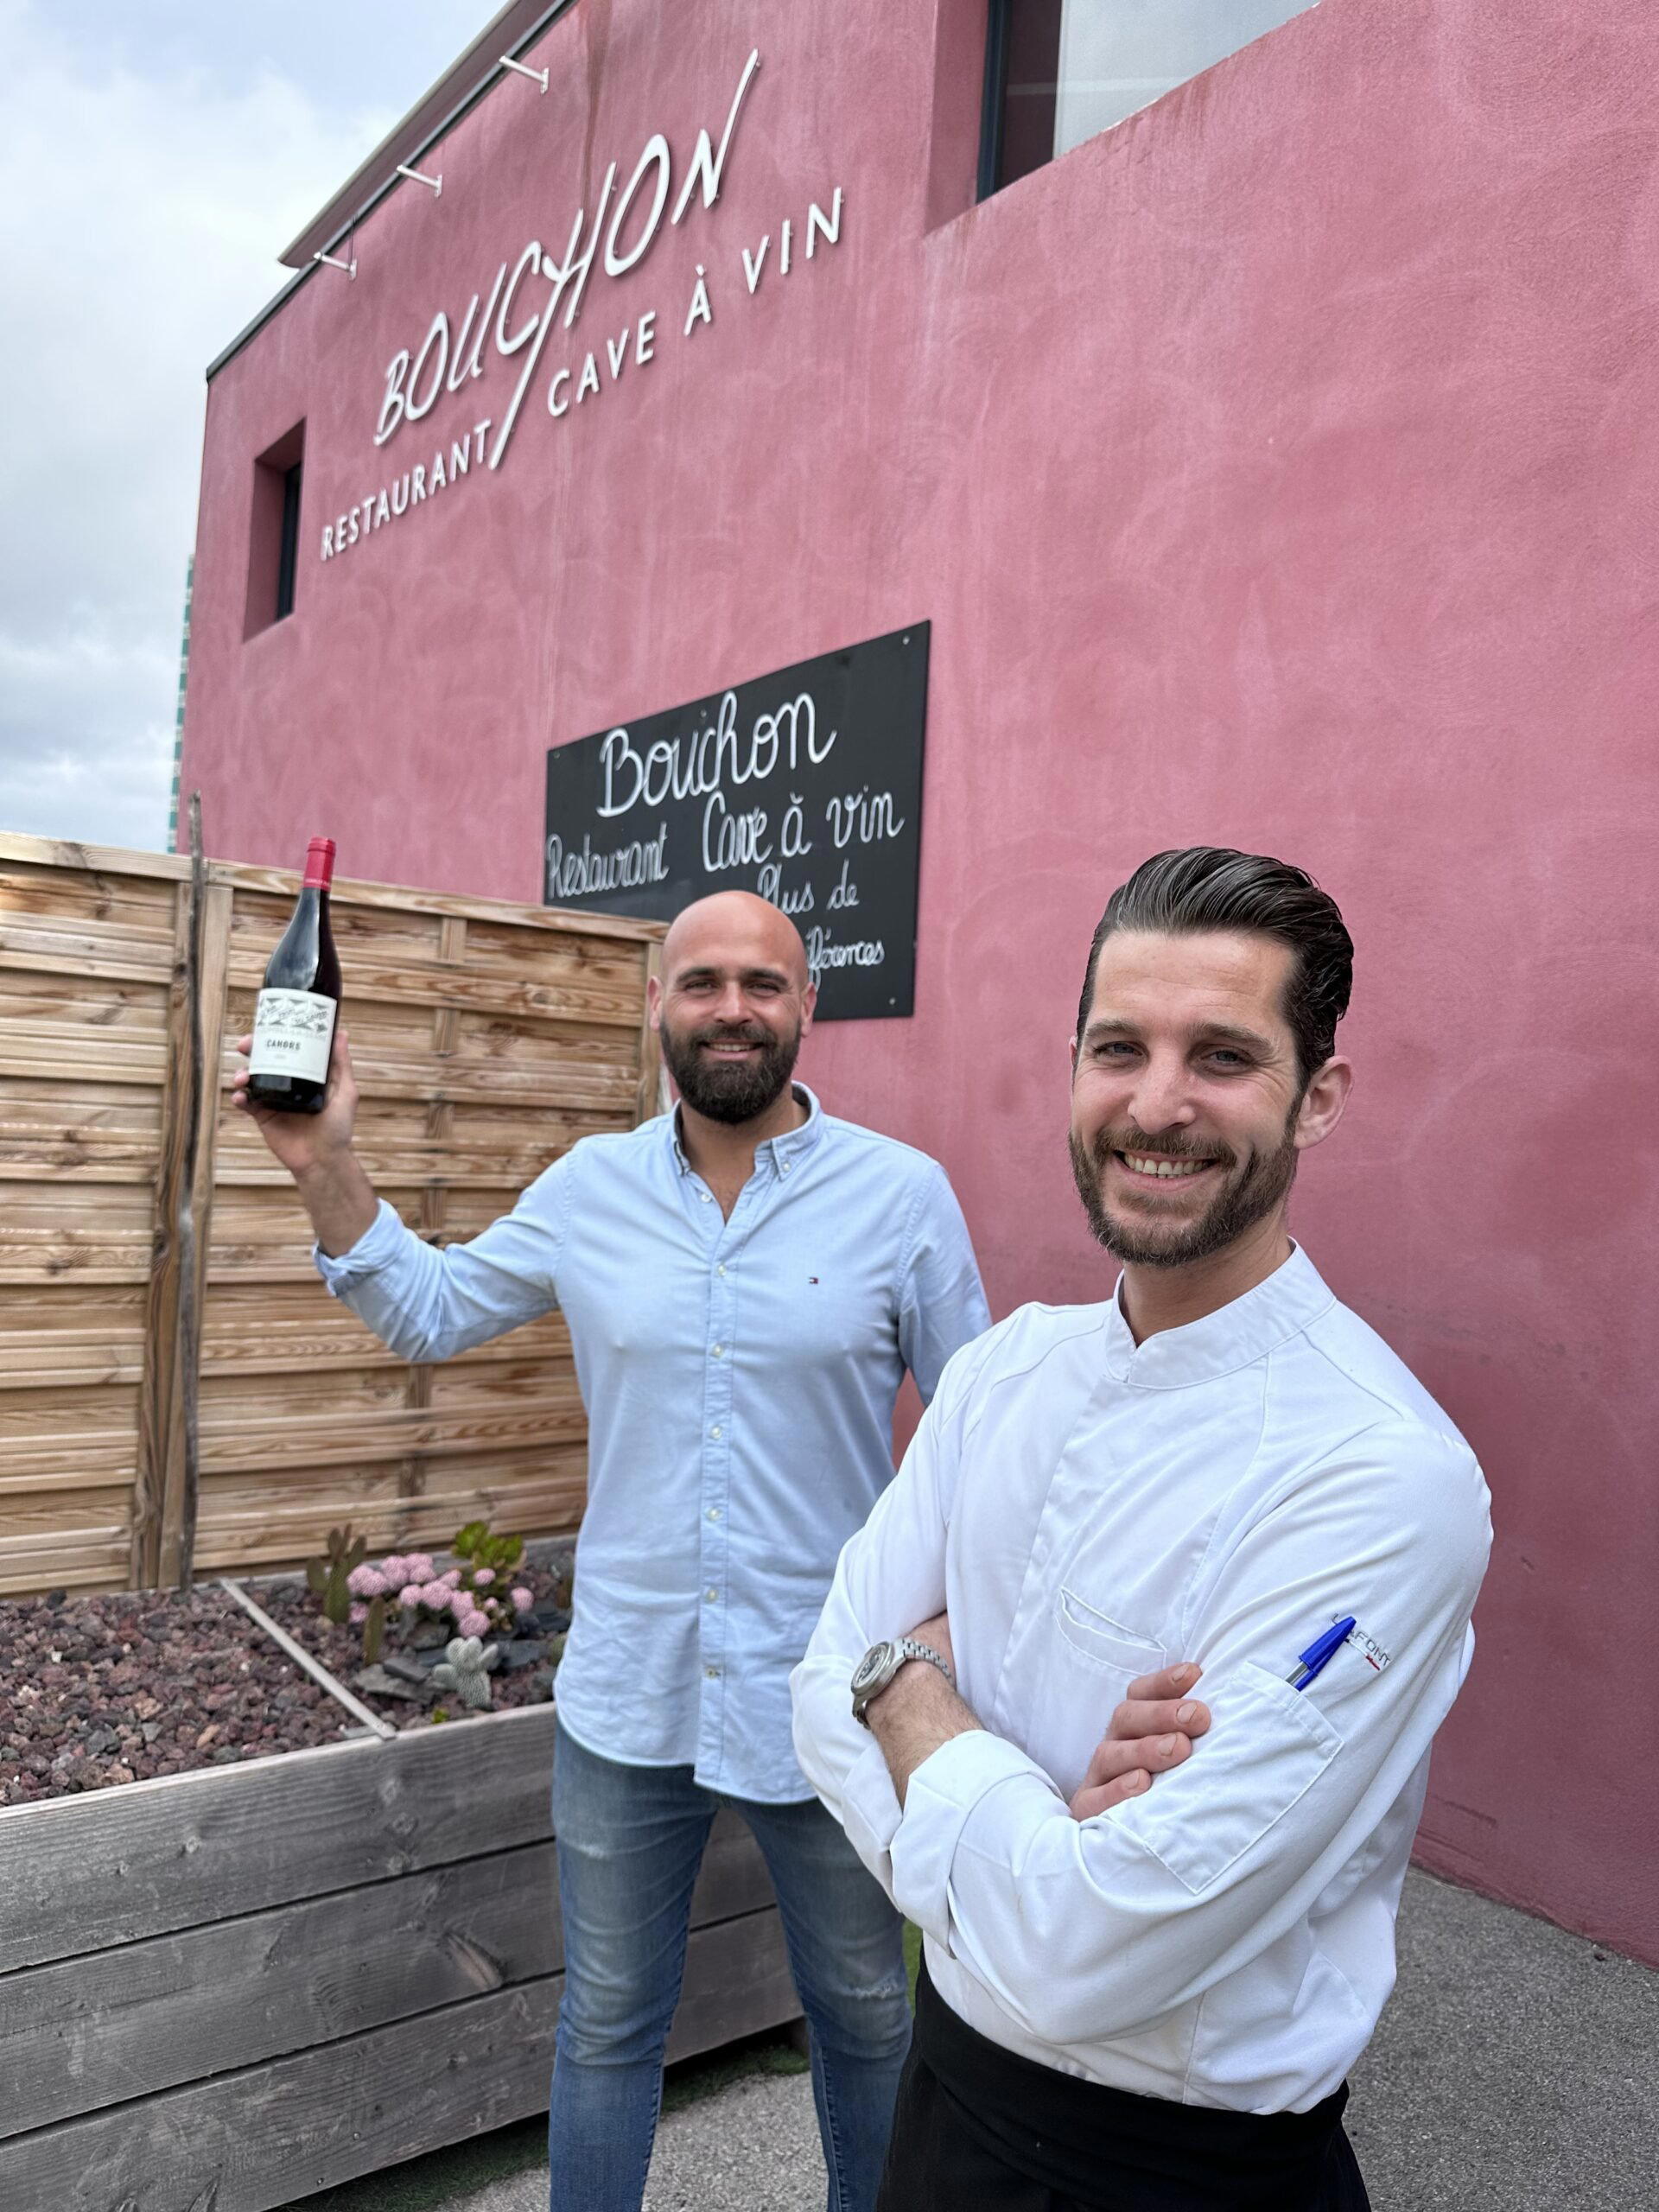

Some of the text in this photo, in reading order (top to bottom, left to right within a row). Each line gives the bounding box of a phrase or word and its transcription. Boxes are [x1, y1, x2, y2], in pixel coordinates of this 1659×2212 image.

[373, 48, 760, 470] BOUCHON
[321, 186, 843, 562] RESTAURANT CAVE À VIN
[596, 690, 837, 817] Bouchon
[545, 785, 905, 899] Restaurant Cave à vin
[757, 858, 860, 915] Plus de
[805, 925, 885, 993] férences
